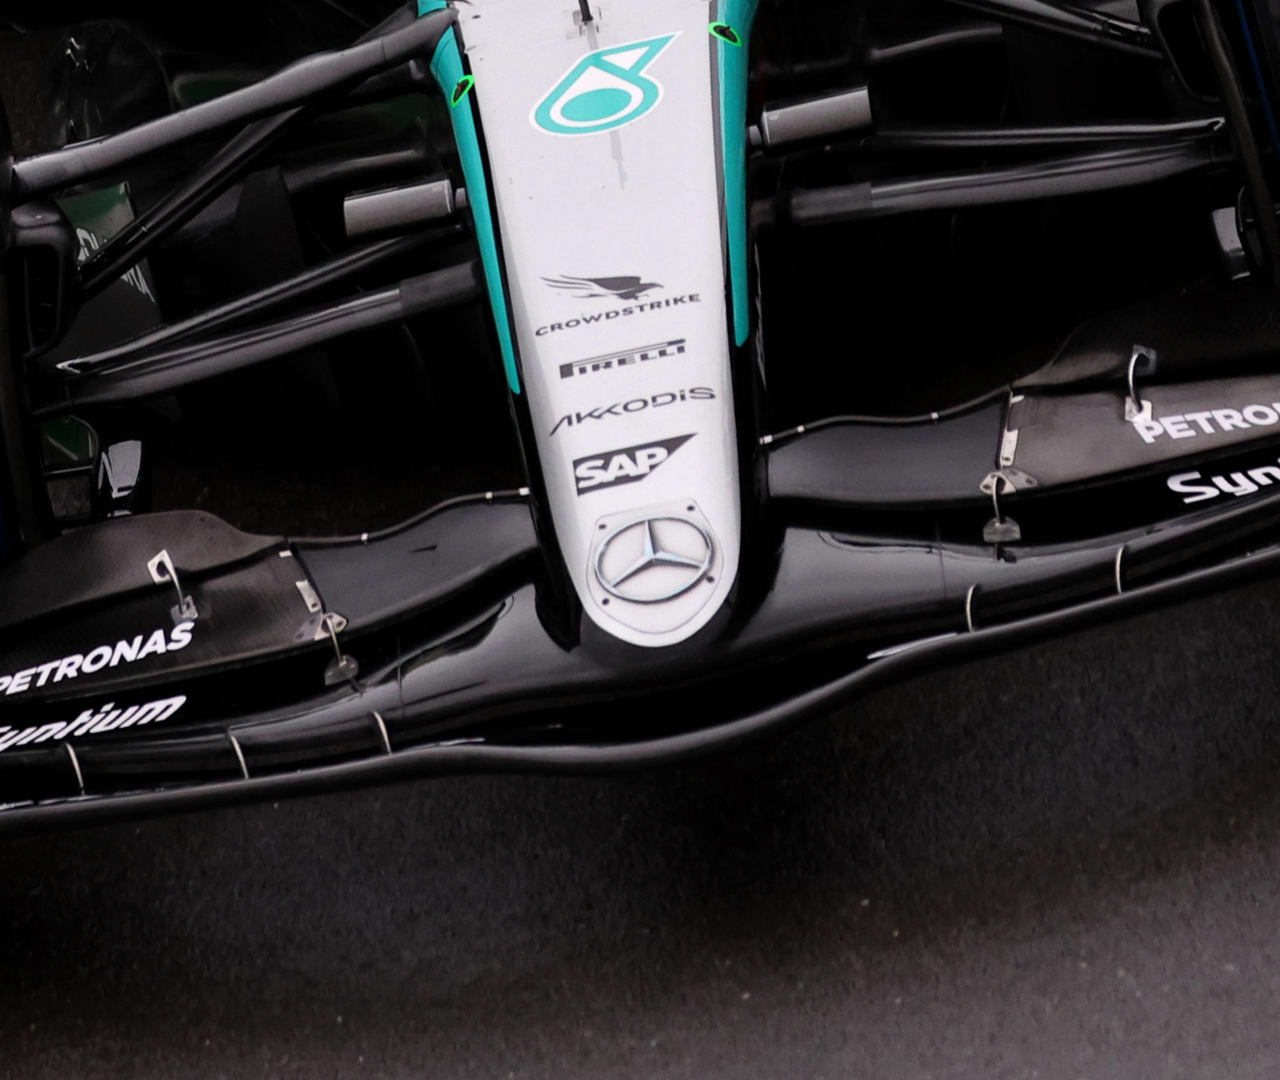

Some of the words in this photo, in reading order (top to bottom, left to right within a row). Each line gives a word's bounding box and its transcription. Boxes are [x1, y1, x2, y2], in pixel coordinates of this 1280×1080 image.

[535, 293, 702, 337] CROWDSTRIKE
[559, 338, 686, 380] PIRELLI
[575, 446, 669, 488] SAP
